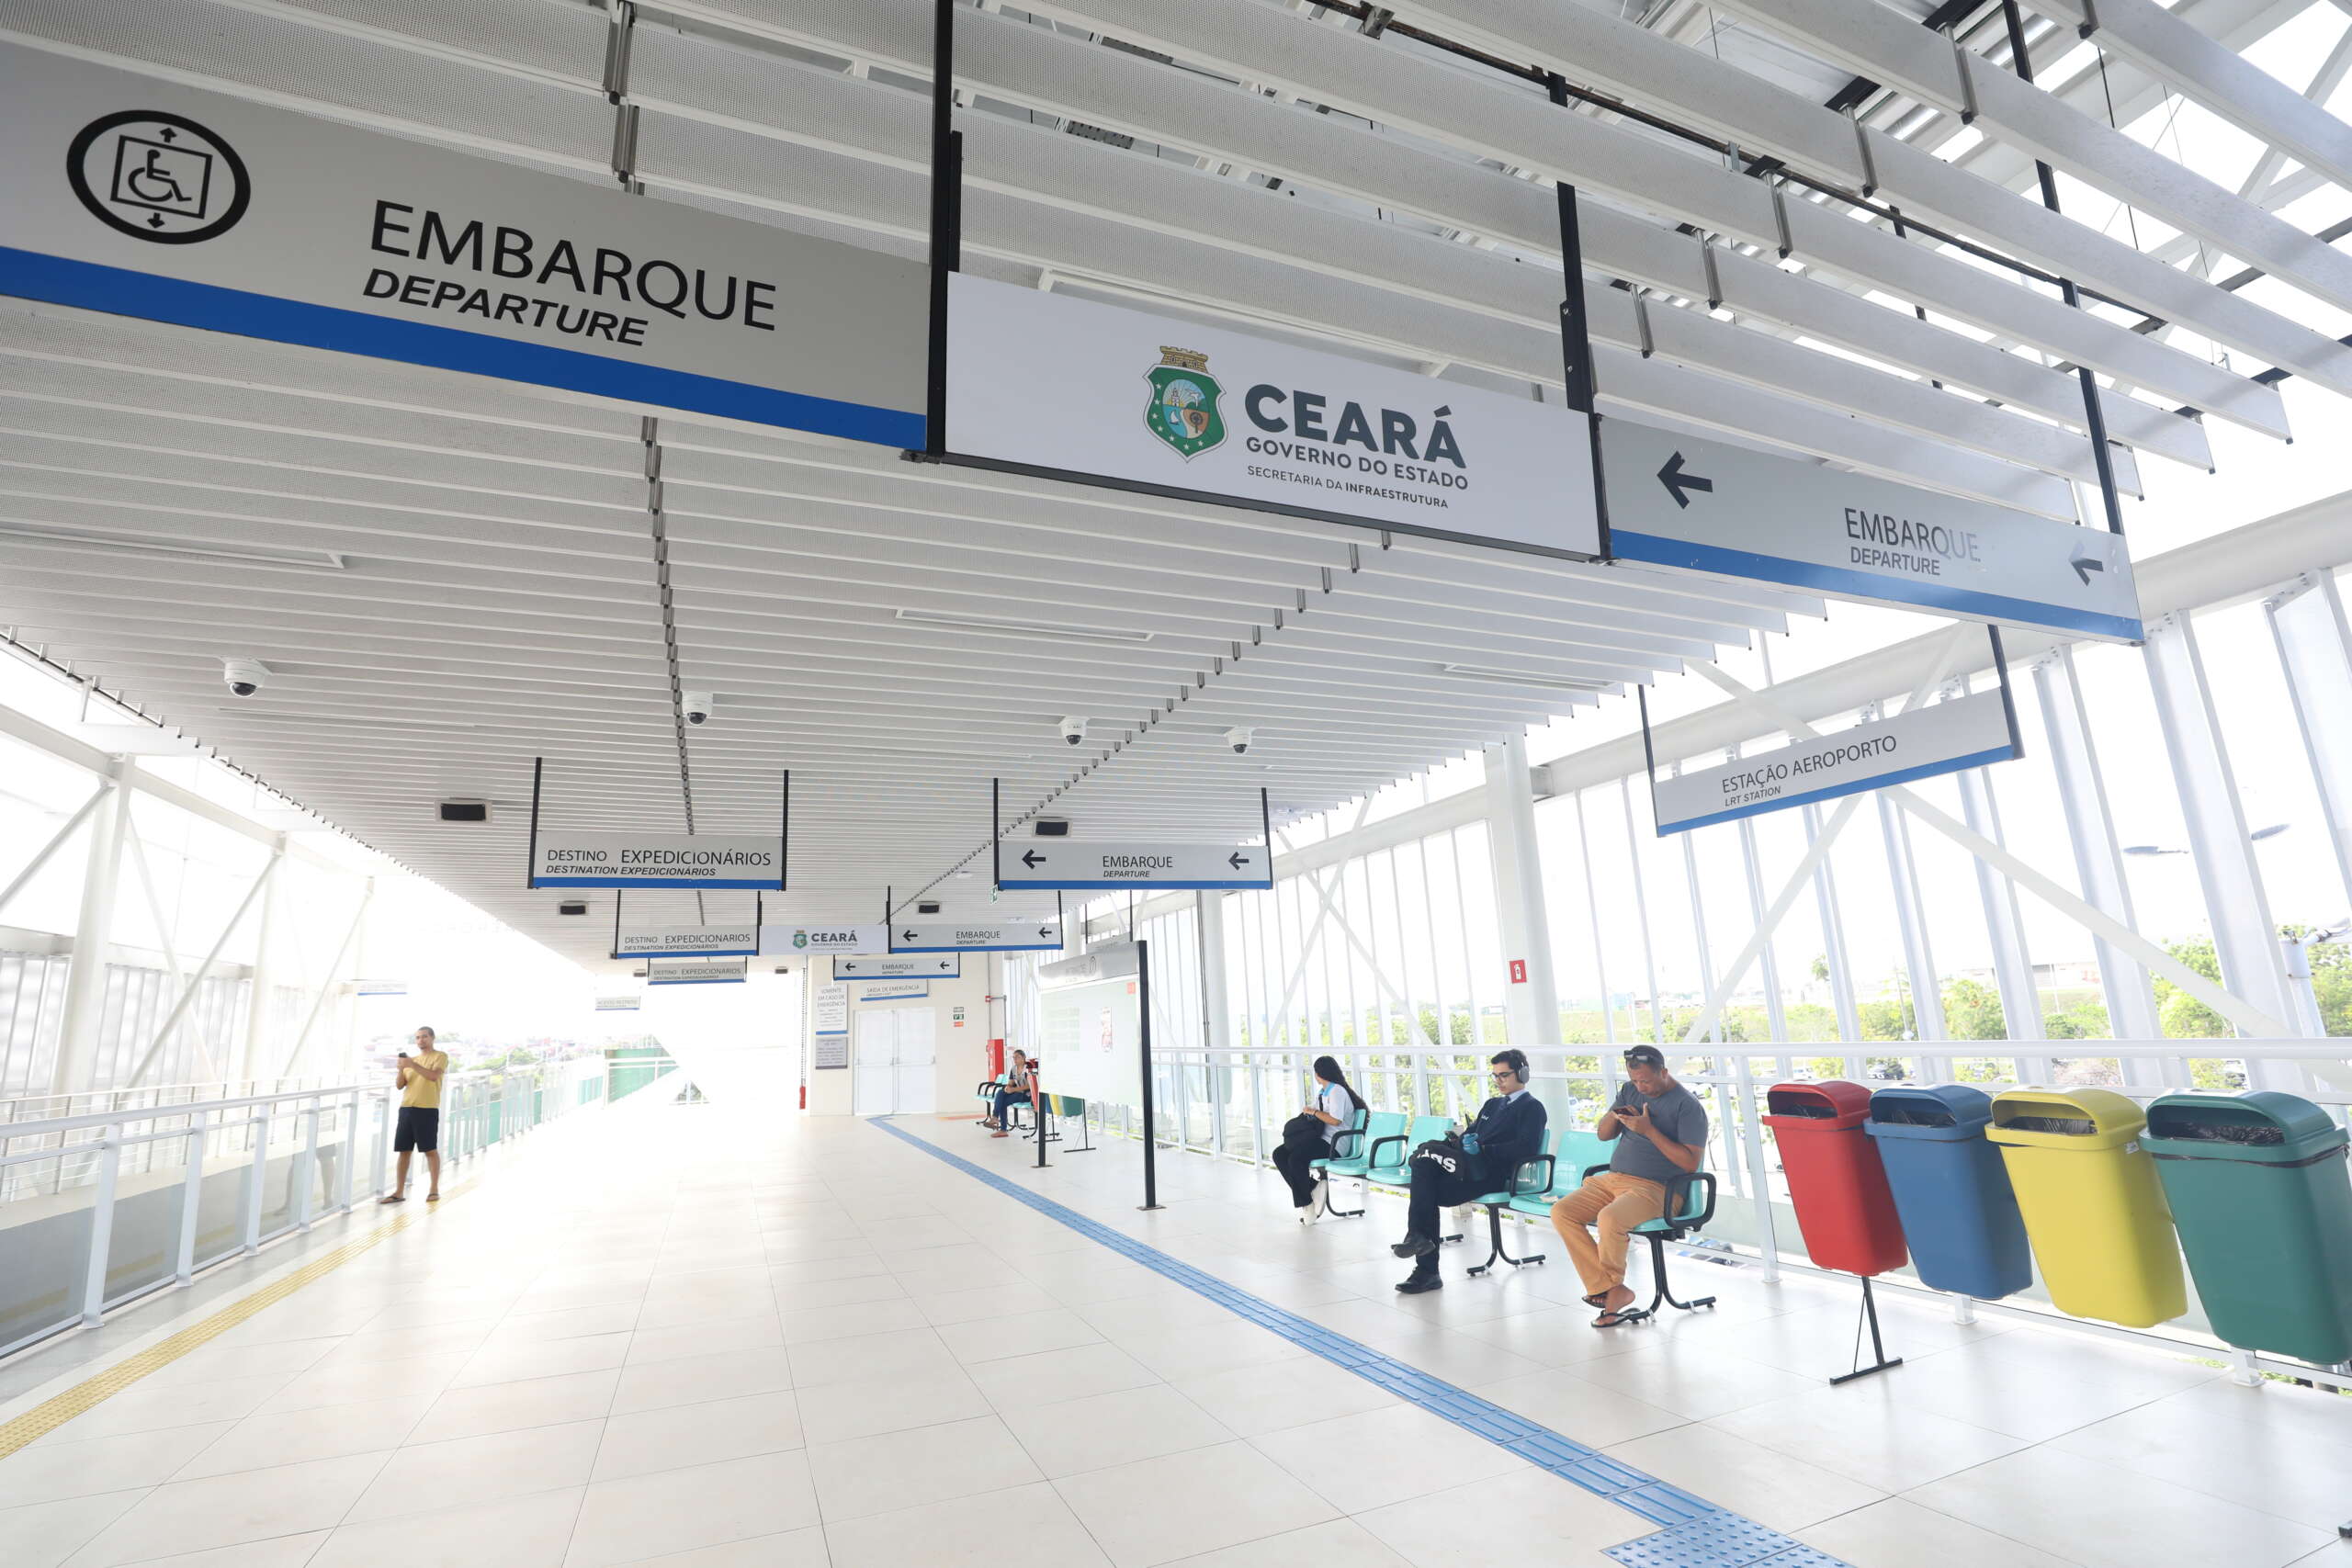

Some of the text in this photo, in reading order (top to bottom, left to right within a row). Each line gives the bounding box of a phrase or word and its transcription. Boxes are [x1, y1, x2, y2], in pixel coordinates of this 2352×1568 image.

[370, 199, 776, 332] EMBARQUE
[362, 267, 649, 347] DEPARTURE
[1244, 383, 1467, 469] CEARÁ
[1246, 436, 1468, 491] GOVERNO DO ESTADO
[1248, 465, 1449, 509] SECRETARIA DA INFRAESTRUTURA
[1844, 506, 1979, 562] EMBARQUE
[1850, 546, 1940, 576] DEPARTURE
[1722, 735, 1897, 795] ESTAÇÃO AEROPORTO
[1724, 786, 1781, 807] LRT STATION
[546, 865, 618, 874] DESTINATION
[547, 848, 771, 866] DESTINO EXPEDICIONÁRIOS
[1102, 855, 1173, 869] EMBARQUE
[1103, 870, 1150, 878] DEPARTURE
[811, 930, 858, 942] CEARÁ
[956, 931, 1001, 940] EMBARQUE
